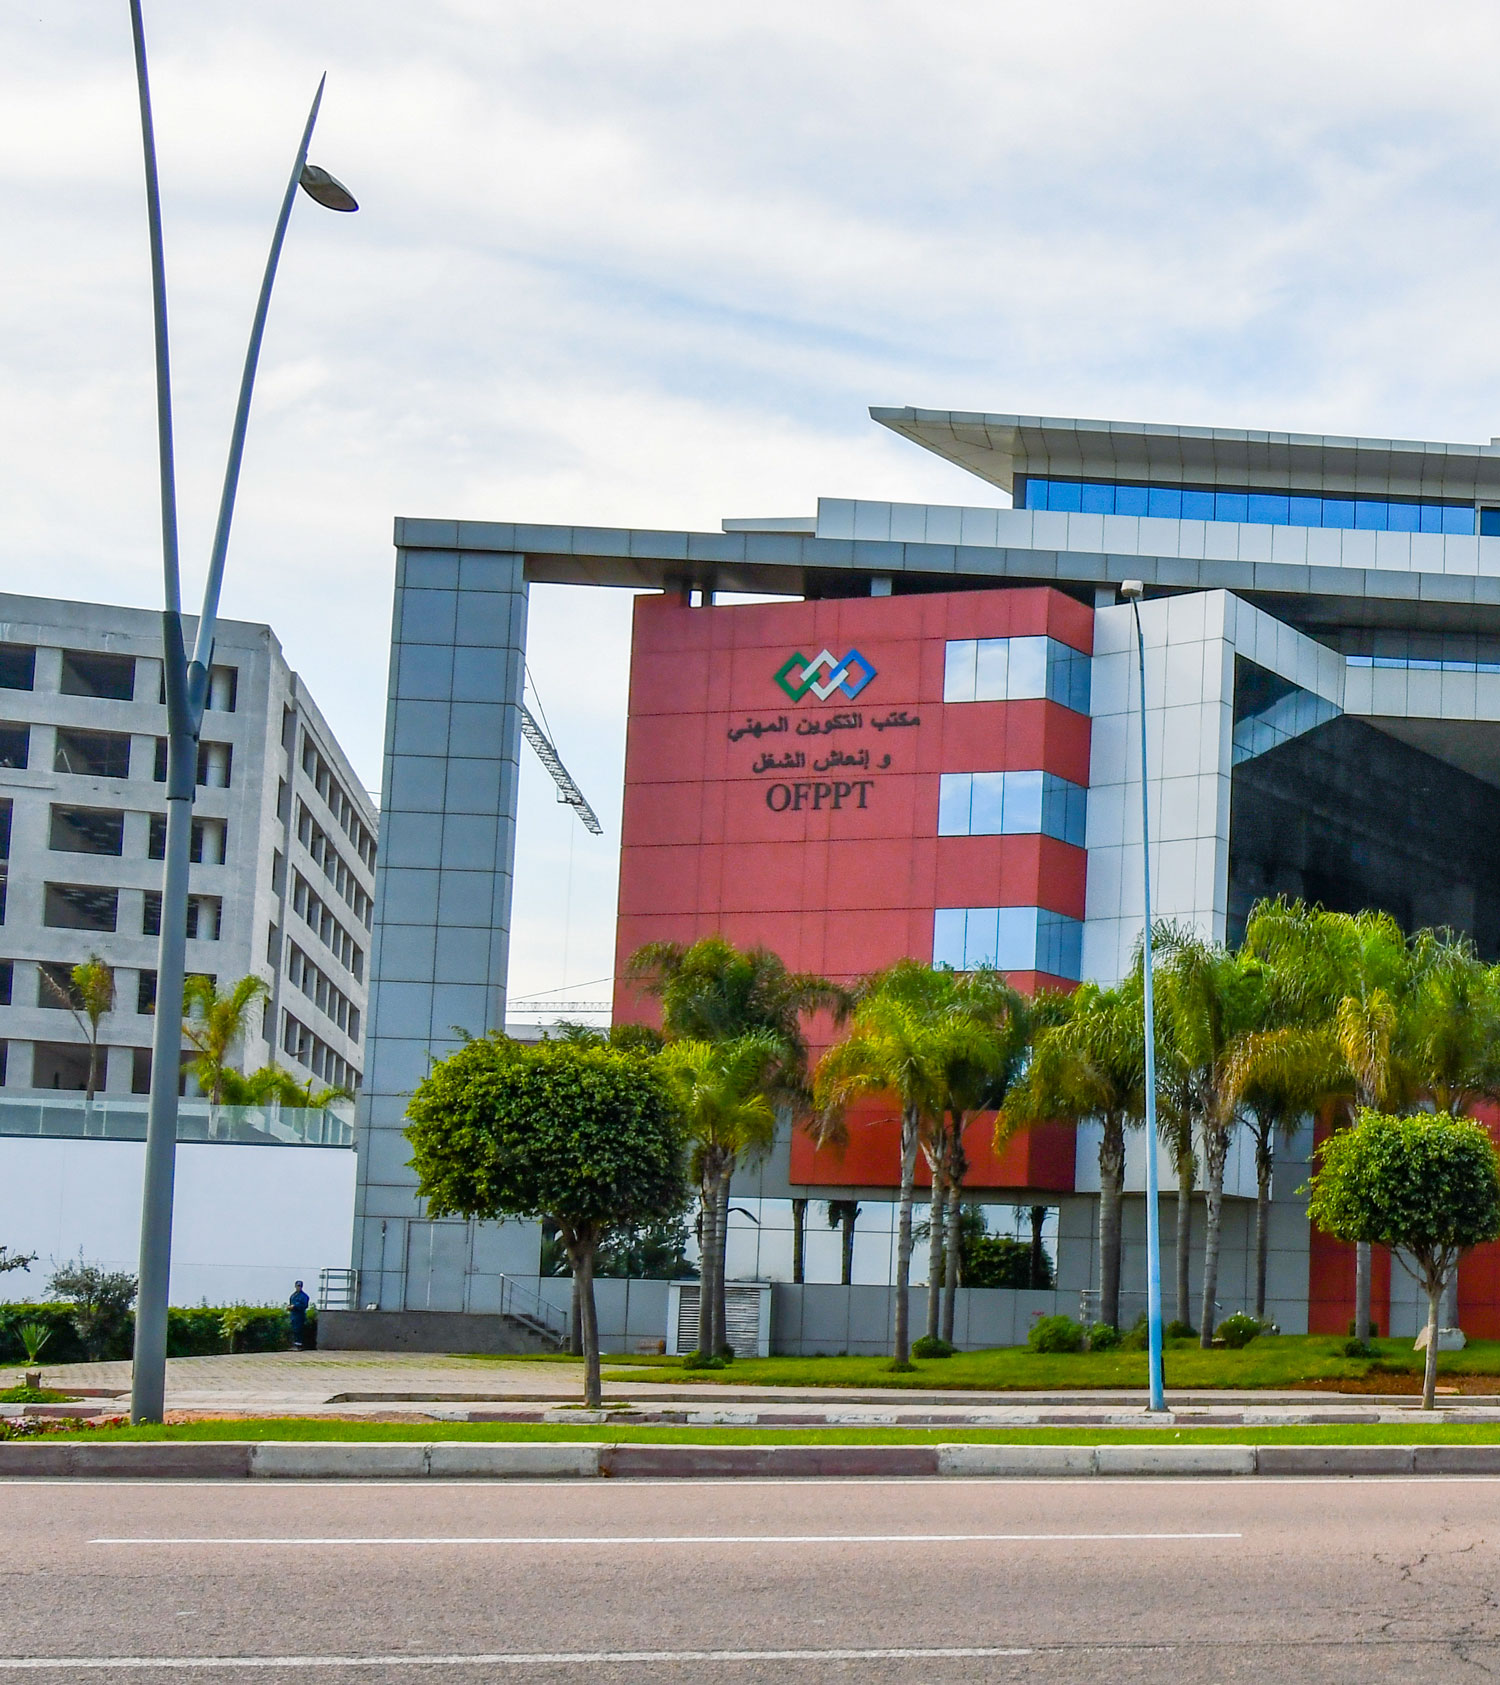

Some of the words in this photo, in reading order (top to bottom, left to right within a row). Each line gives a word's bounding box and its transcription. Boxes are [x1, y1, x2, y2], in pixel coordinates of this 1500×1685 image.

[728, 716, 788, 741] المهني
[796, 712, 862, 735] التكوين
[871, 712, 920, 731] مكتب
[752, 751, 805, 774] الشغل
[877, 753, 891, 769] و
[766, 780, 874, 812] OFPPT
